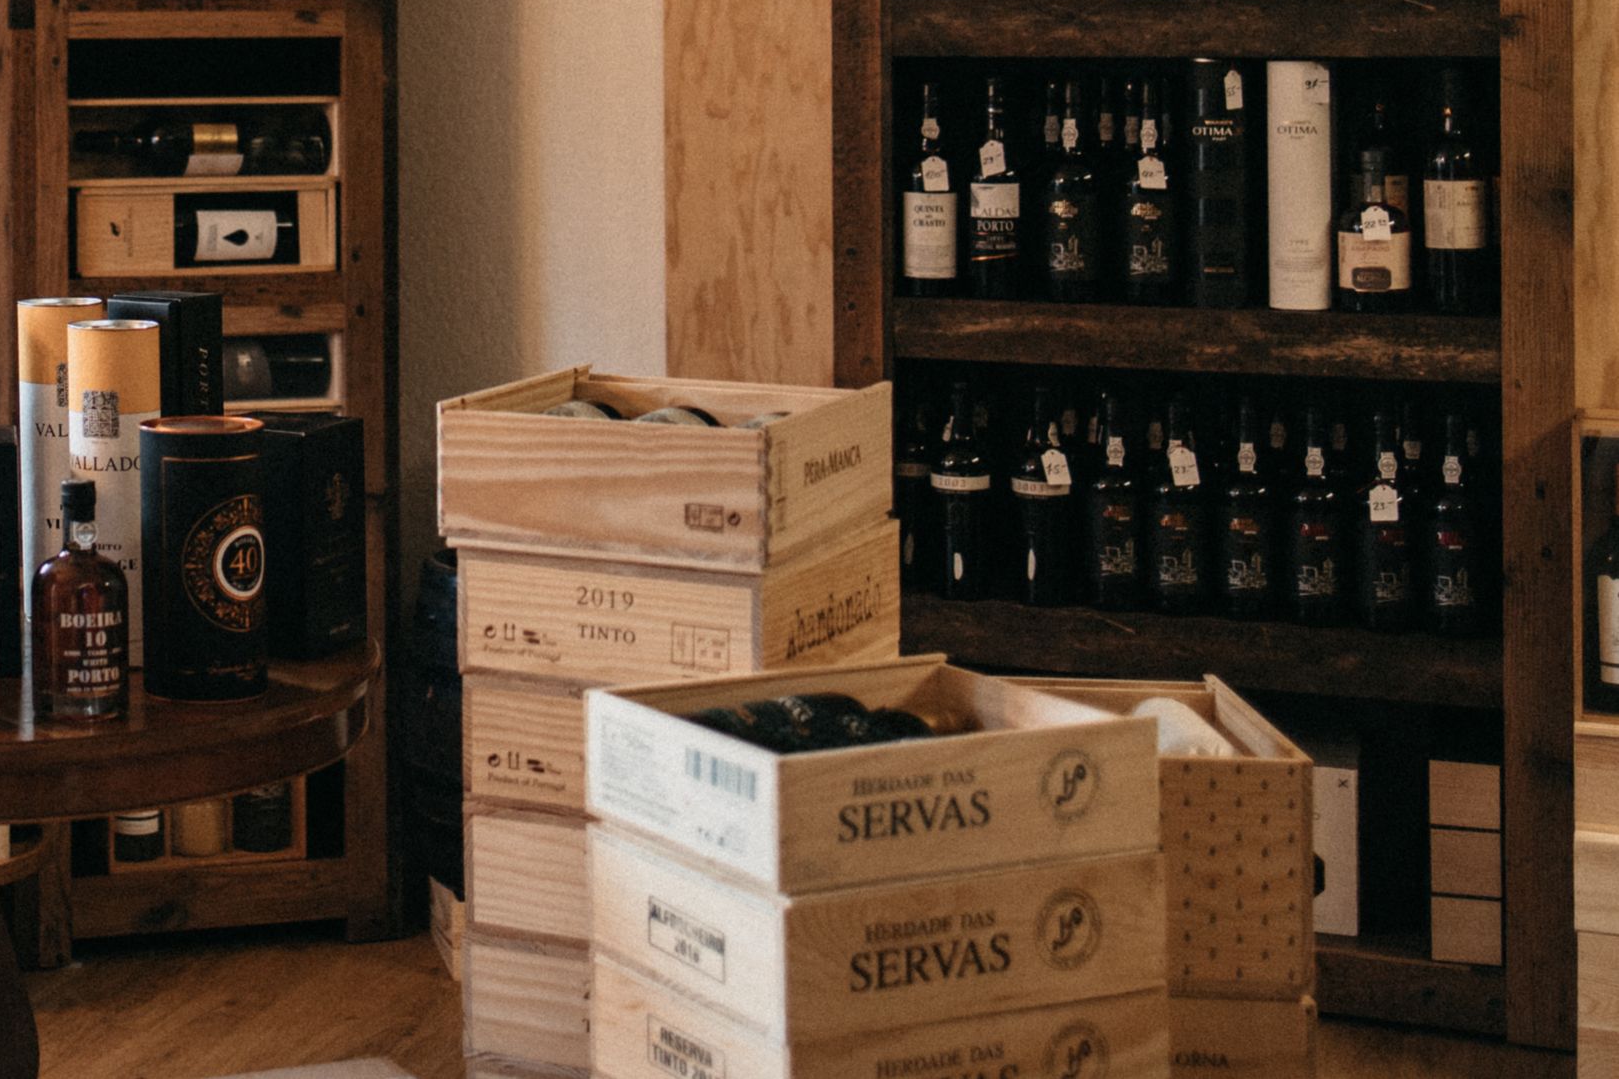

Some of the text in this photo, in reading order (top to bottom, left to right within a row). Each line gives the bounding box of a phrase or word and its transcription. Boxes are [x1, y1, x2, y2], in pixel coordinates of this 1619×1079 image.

[1276, 126, 1319, 136] OTIMA
[913, 204, 945, 214] QUINTA
[976, 220, 1014, 233] PORTO
[230, 546, 258, 576] 40
[576, 586, 635, 610] 2019
[60, 611, 122, 629] BOEIRA
[85, 630, 107, 649] 10
[577, 623, 637, 645] TINTO
[67, 667, 119, 683] PORTO
[852, 770, 975, 796] HERDADE DAS
[837, 789, 992, 843] SERVAS
[864, 910, 996, 944] HERDADE DAS
[849, 932, 1012, 993] SERVAS
[660, 1026, 713, 1068] RESERVA
[652, 1044, 688, 1077] TINTO
[876, 1046, 964, 1078] HERDADE
[969, 1042, 1005, 1059] DAS
